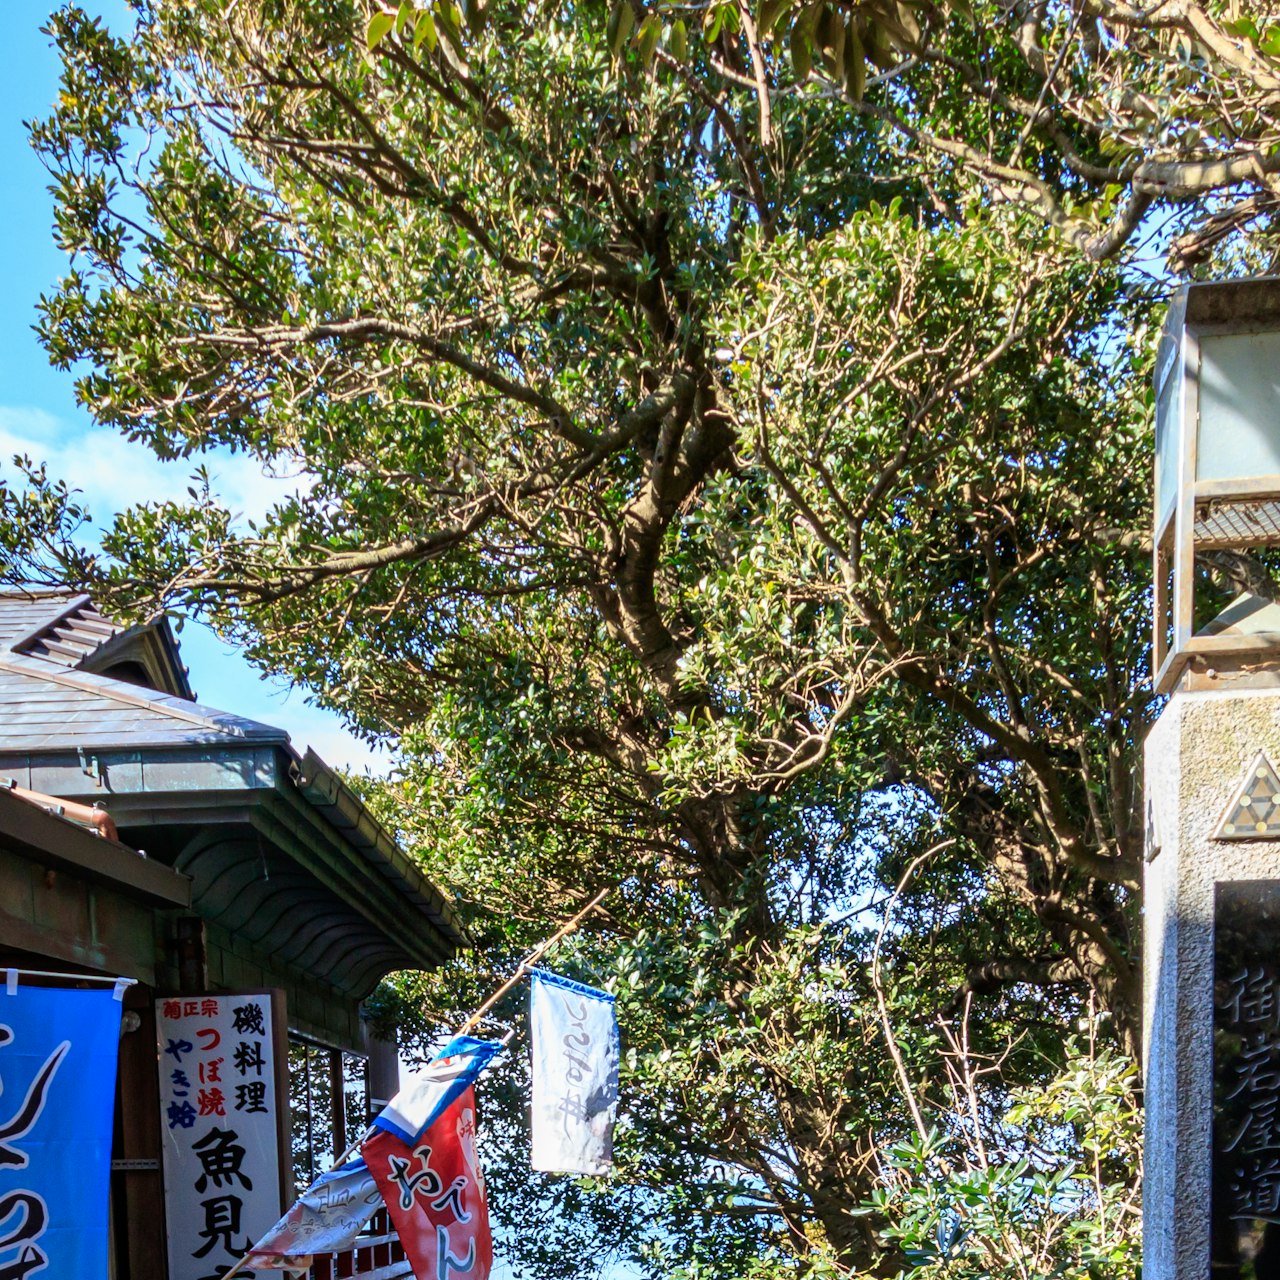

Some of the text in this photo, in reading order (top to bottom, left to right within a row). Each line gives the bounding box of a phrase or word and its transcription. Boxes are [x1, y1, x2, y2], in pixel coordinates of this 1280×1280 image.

[163, 998, 219, 1020] 菊正宗
[164, 1038, 198, 1130] やき蛤
[196, 1028, 226, 1116] つぼ焼
[231, 1002, 269, 1114] 磯料理
